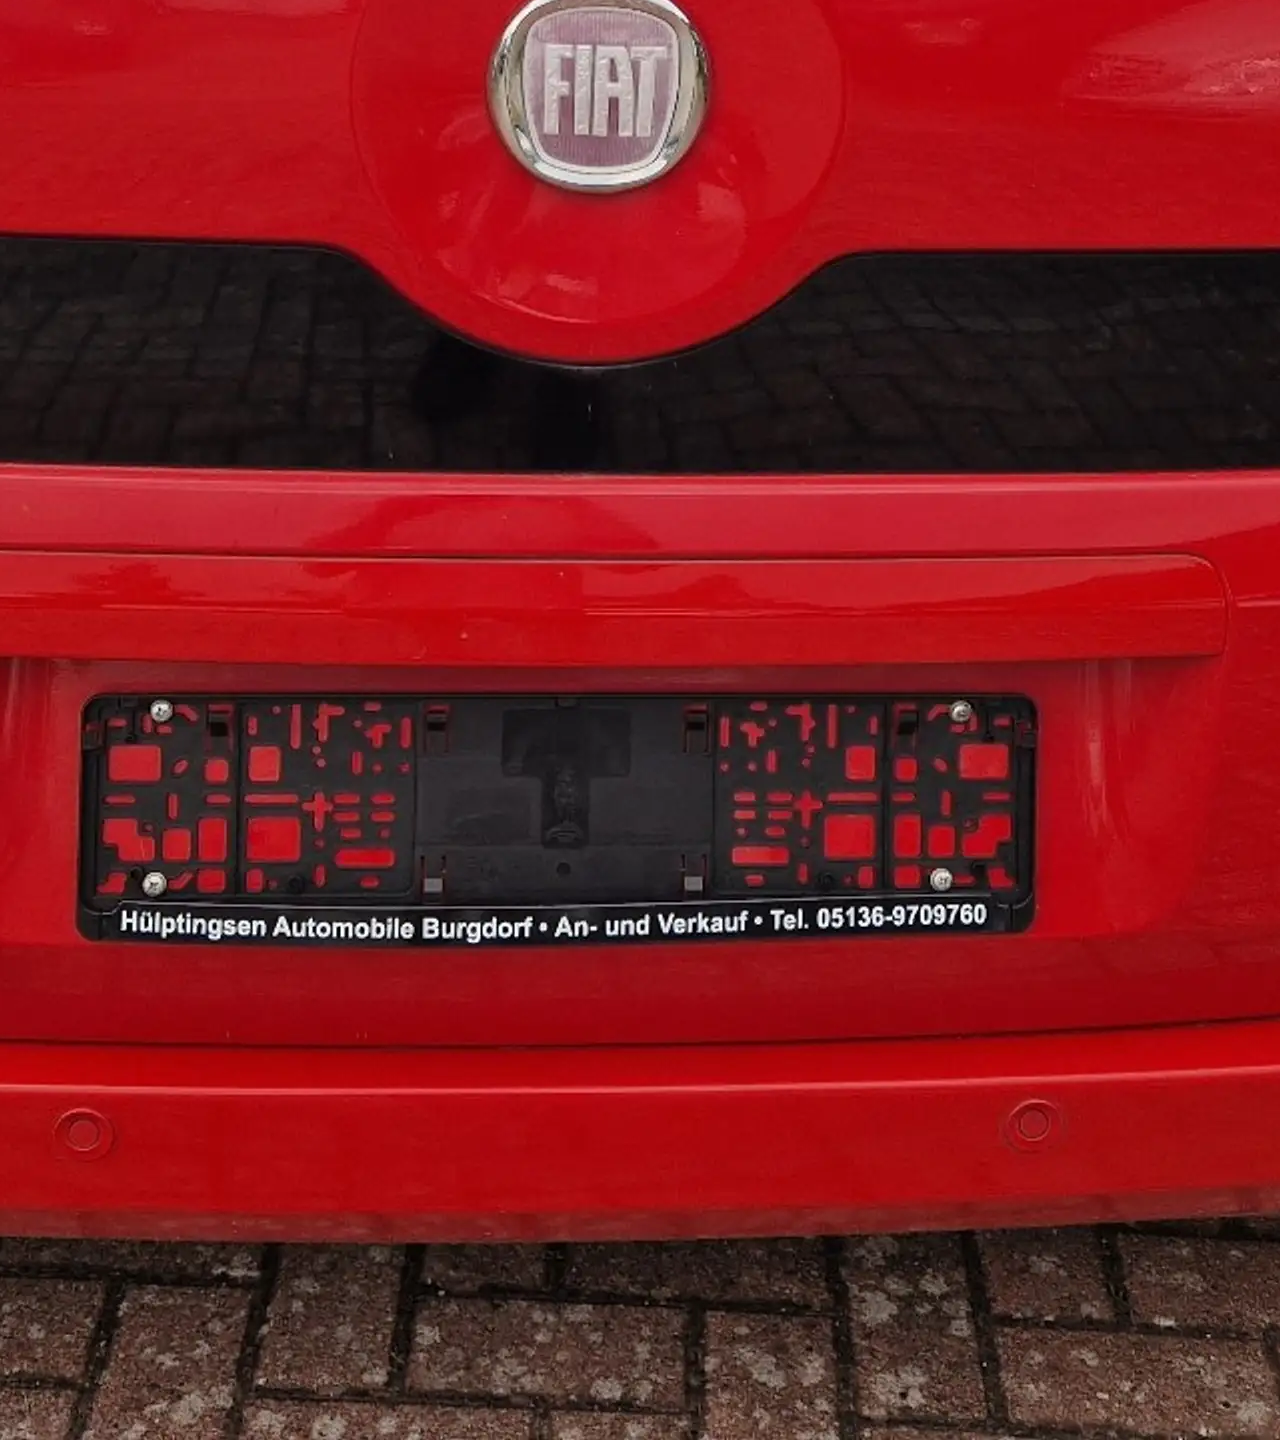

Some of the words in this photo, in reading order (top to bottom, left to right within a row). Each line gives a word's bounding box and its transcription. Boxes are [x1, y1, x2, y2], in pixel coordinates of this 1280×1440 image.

[542, 43, 668, 138] FIAT
[120, 910, 268, 941] Hülptingsen
[272, 915, 415, 940] Automobile
[421, 916, 533, 944] Burgdorf
[554, 915, 598, 938] An-
[605, 913, 651, 937] und
[657, 910, 749, 935] Verkauf
[770, 908, 810, 932] Tel.
[816, 903, 988, 929] 05136-9709760
